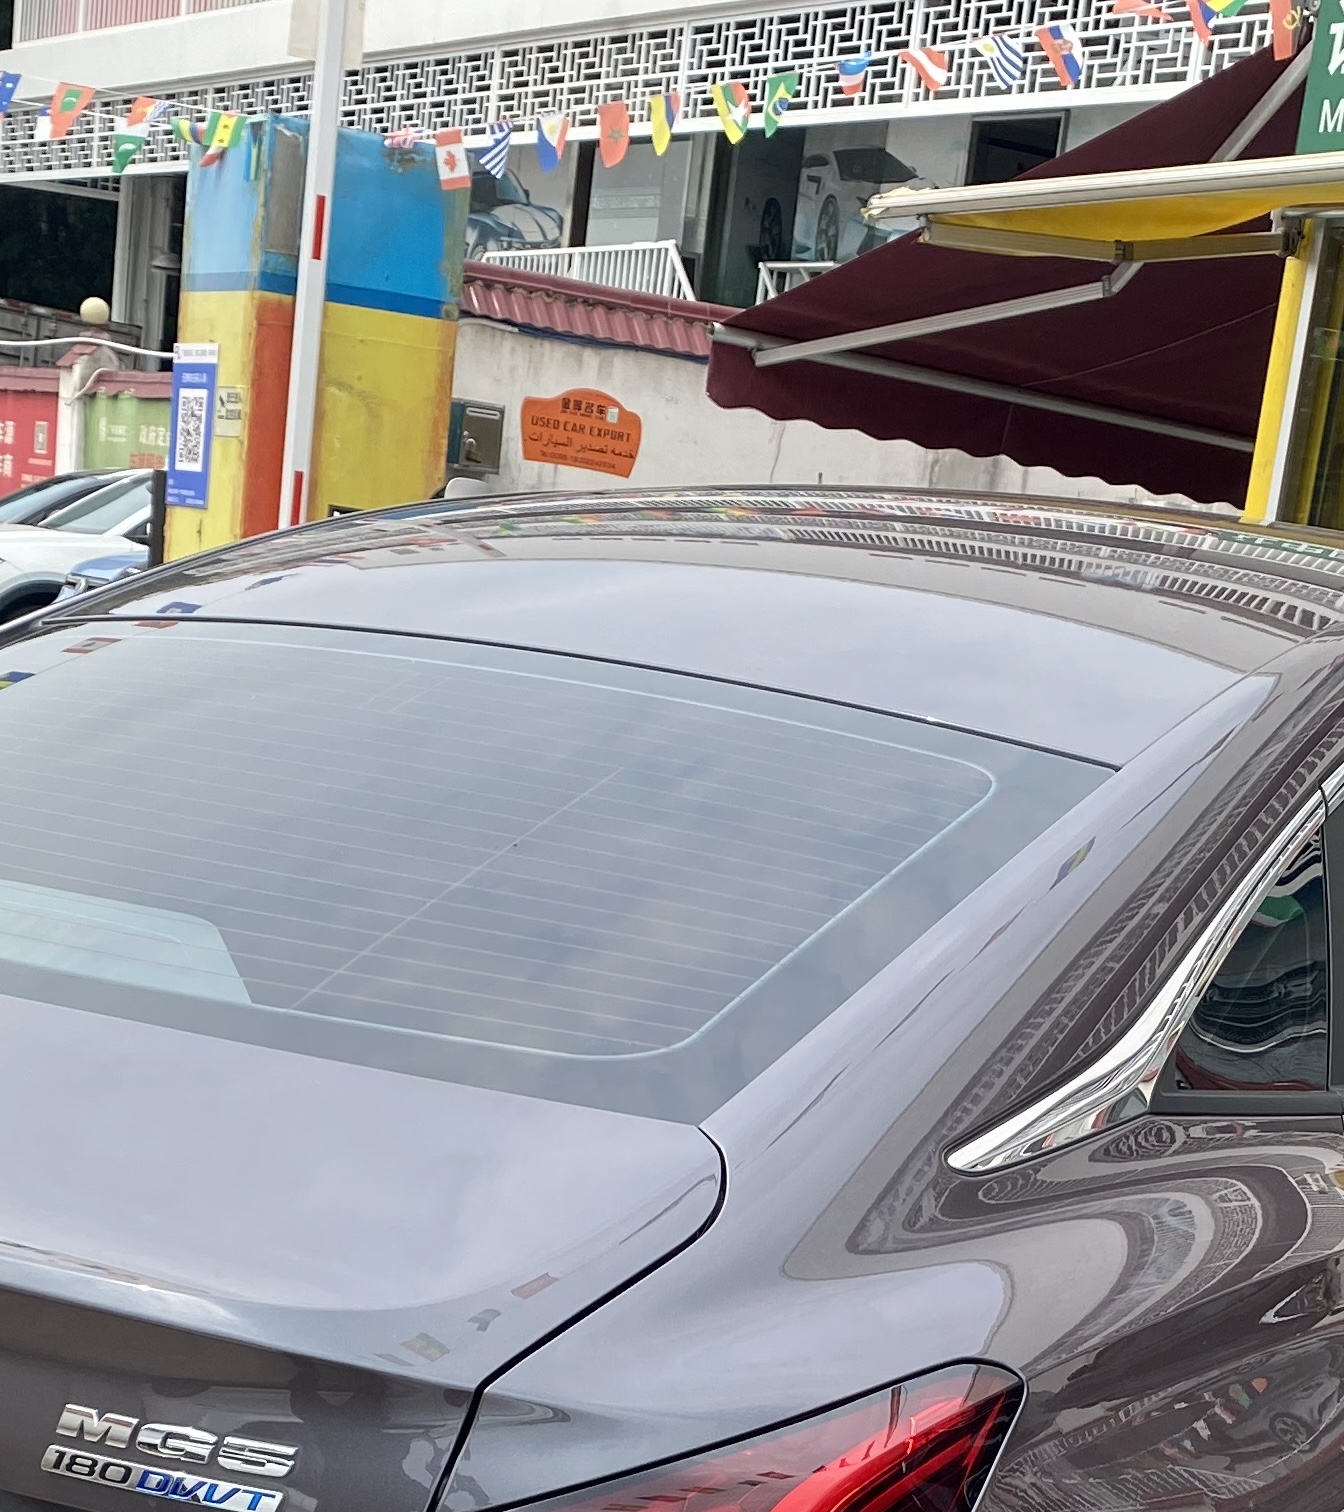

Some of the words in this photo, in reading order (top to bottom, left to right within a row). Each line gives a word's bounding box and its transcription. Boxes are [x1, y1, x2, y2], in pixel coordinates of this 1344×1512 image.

[531, 415, 560, 430] USED
[563, 421, 586, 434] CAR
[589, 426, 632, 443] EXPORT
